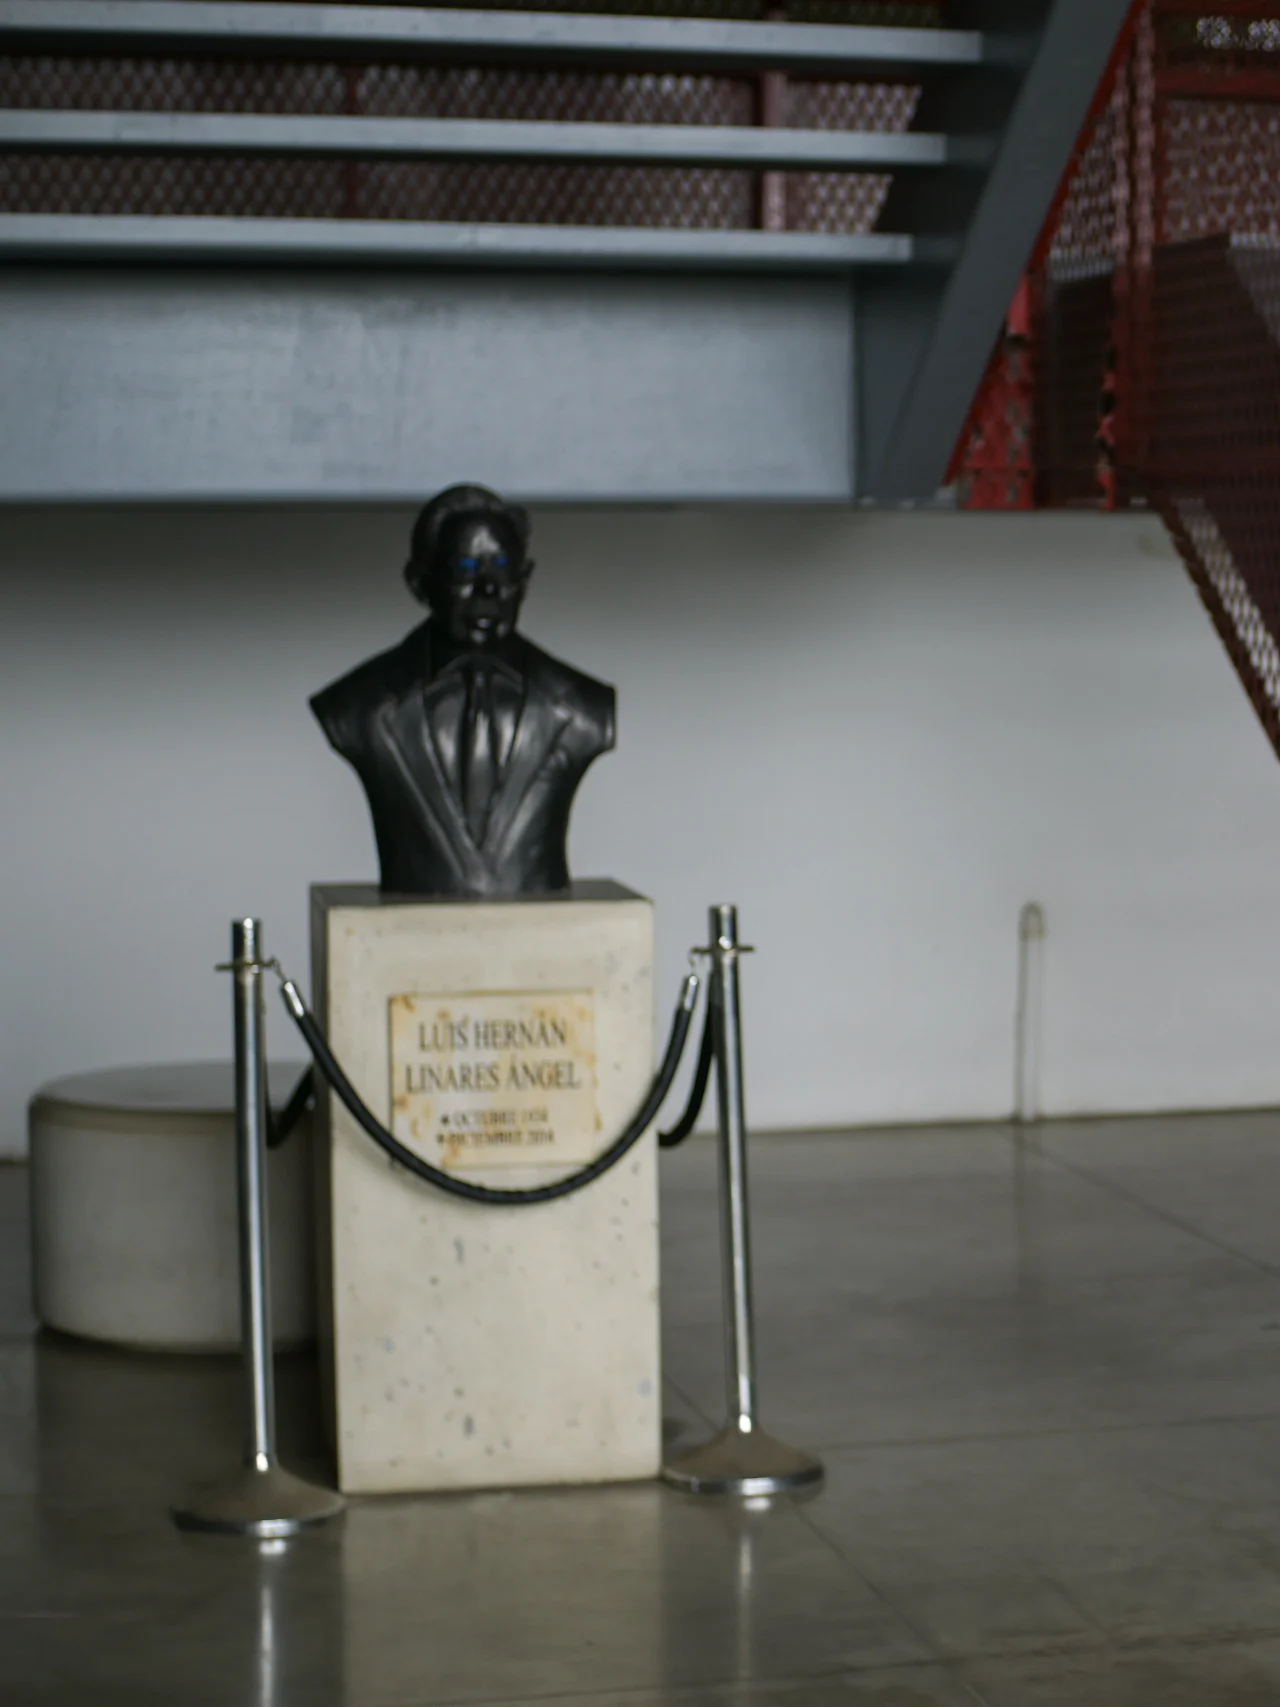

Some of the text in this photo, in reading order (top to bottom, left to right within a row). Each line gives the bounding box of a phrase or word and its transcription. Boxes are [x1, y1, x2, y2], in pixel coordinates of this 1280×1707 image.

[418, 1014, 568, 1052] LUIS HERNÁN
[405, 1055, 581, 1094] LINARES ÁNGEL
